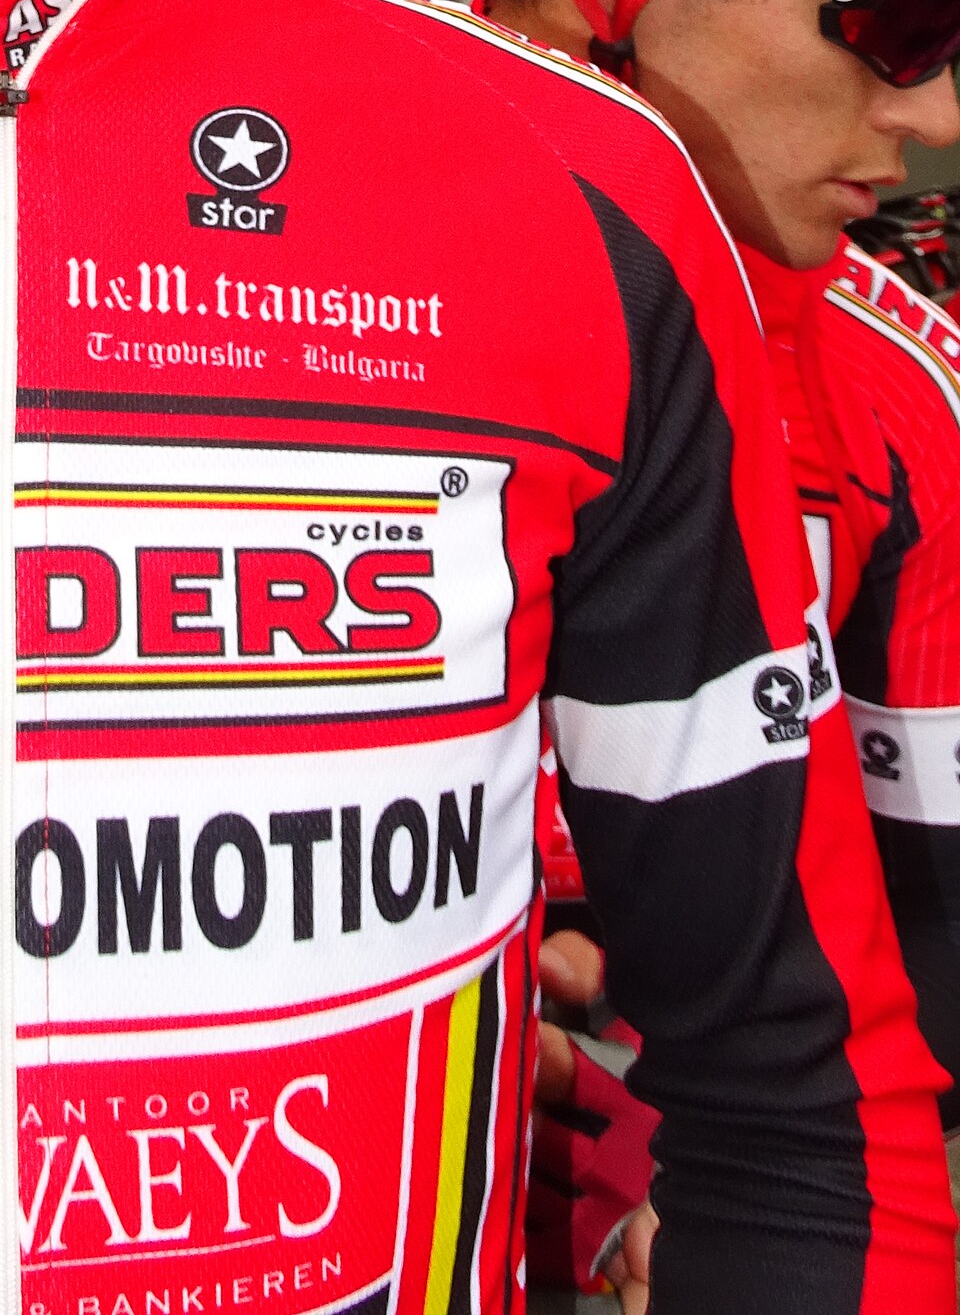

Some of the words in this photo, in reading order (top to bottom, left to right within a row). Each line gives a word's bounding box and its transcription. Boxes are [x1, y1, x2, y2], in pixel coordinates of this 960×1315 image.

[201, 196, 276, 232] star
[301, 343, 426, 383] Bulgaria
[306, 520, 425, 547] cycles
[78, 1252, 341, 1315] BANKIEREN
